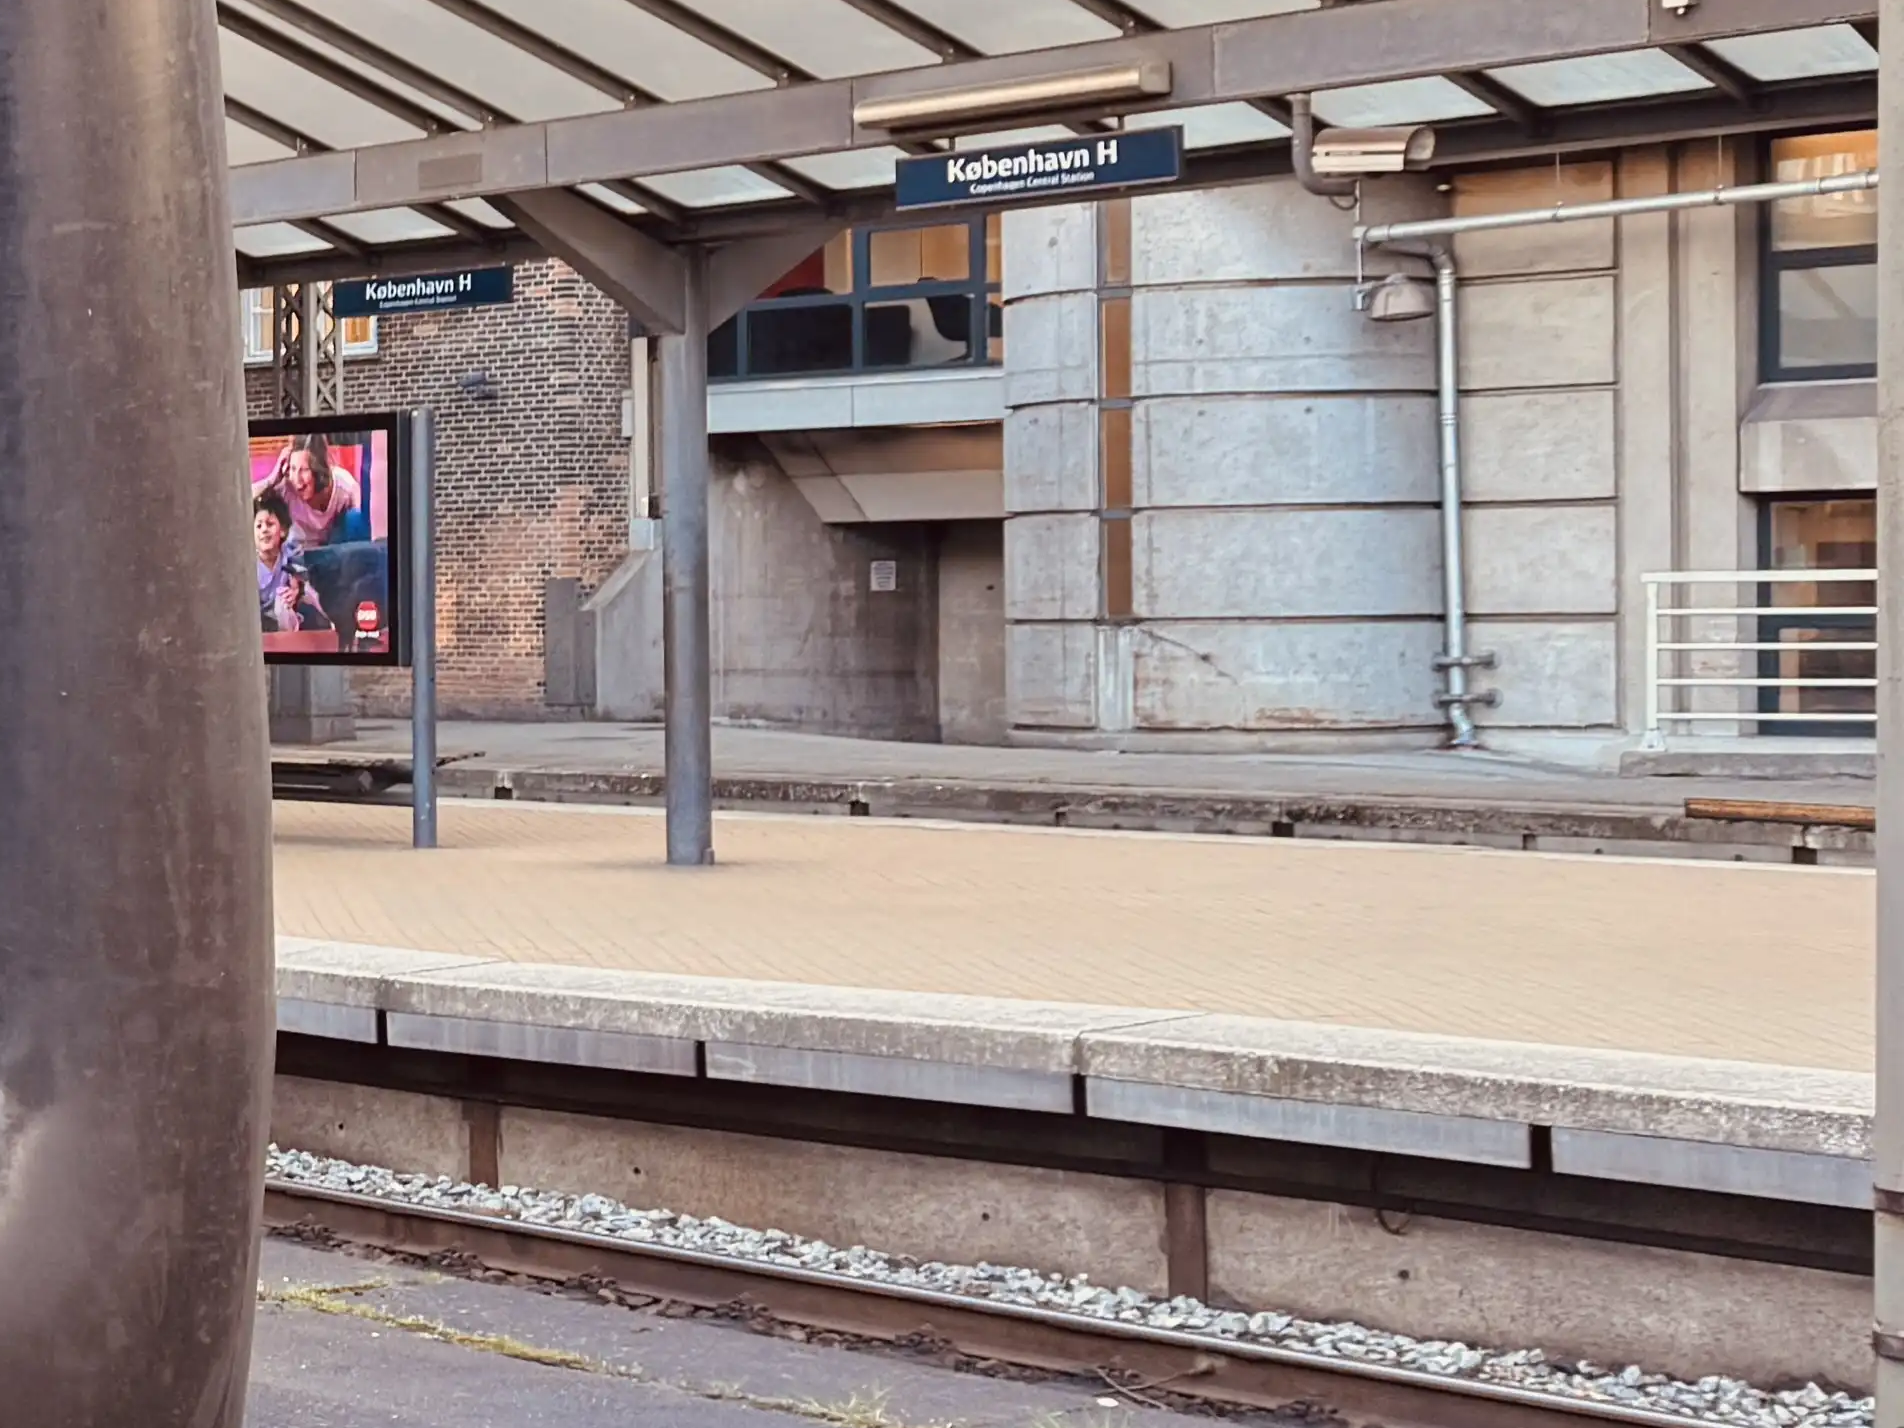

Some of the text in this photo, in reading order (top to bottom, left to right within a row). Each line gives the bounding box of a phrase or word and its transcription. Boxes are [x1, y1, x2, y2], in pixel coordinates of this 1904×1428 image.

[947, 139, 1118, 183] København H
[365, 273, 472, 300] København H
